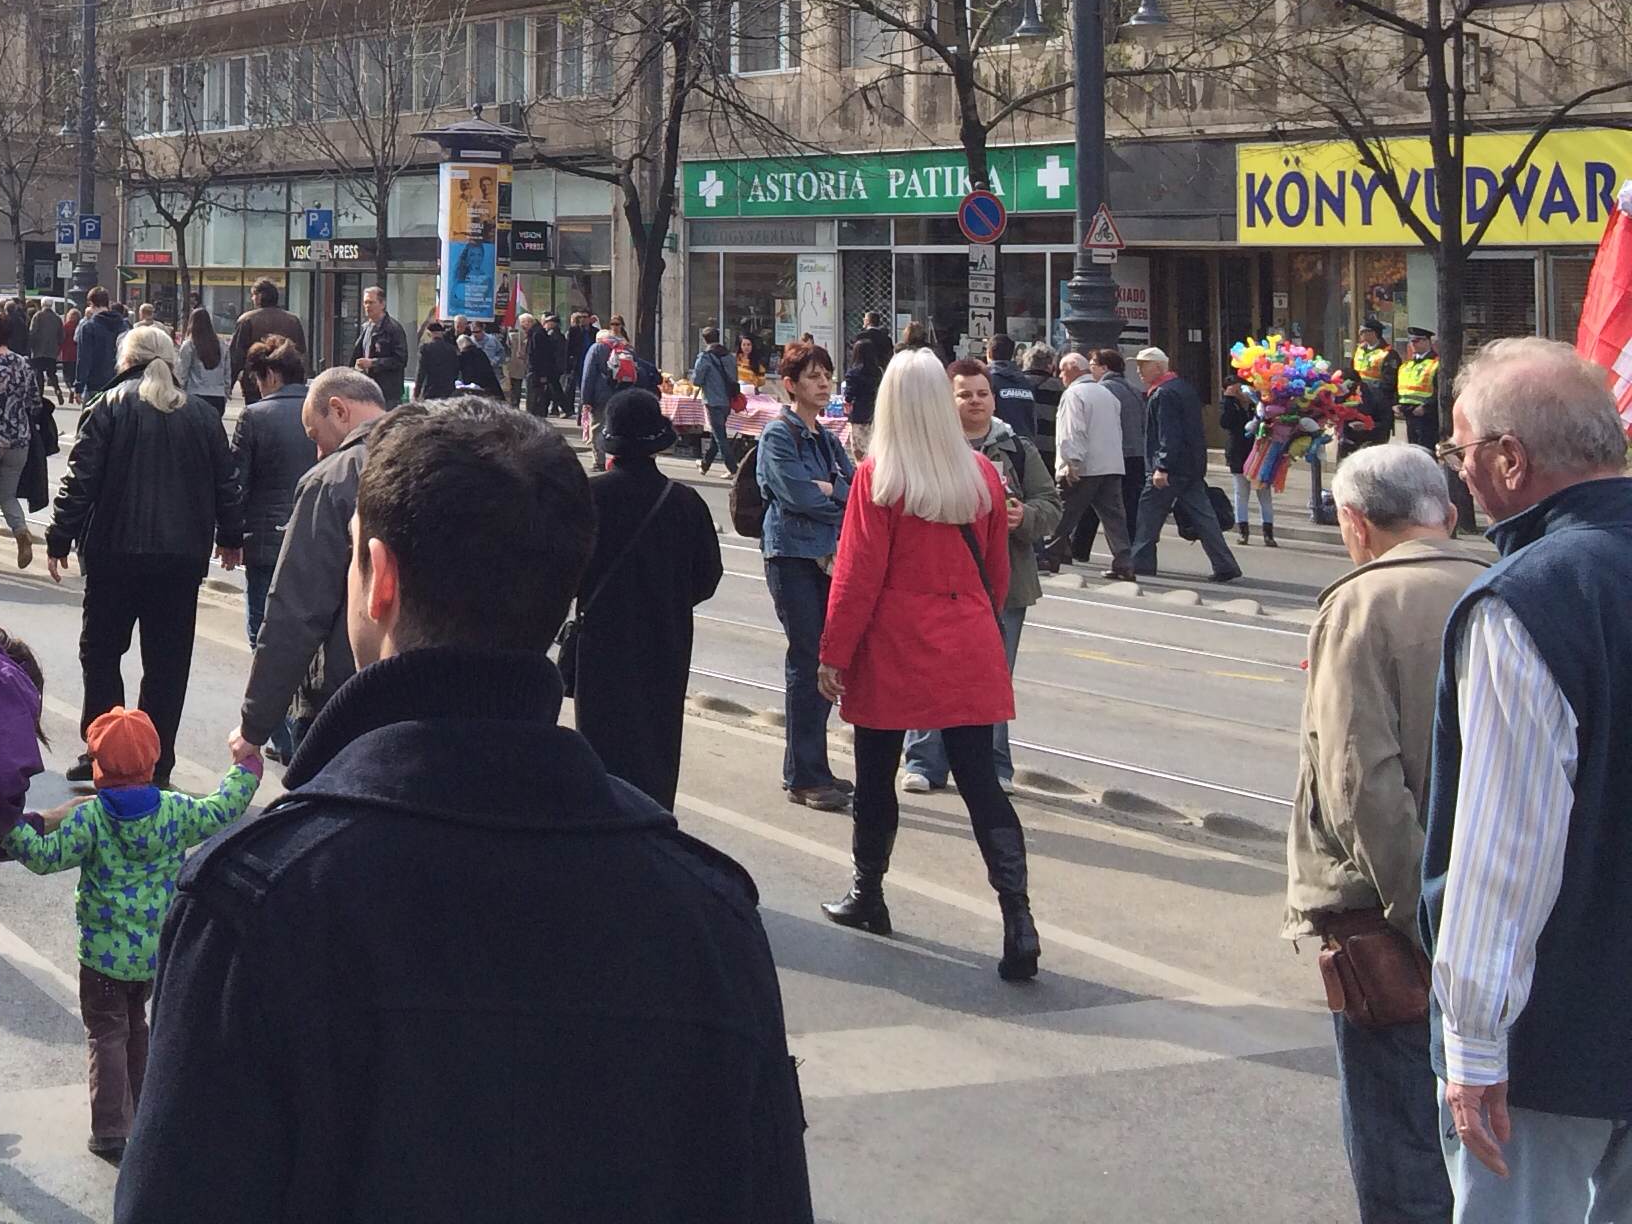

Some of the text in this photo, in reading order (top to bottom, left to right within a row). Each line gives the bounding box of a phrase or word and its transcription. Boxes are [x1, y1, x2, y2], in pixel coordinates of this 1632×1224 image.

[747, 164, 1005, 203] ASTORIA PATIKA
[308, 212, 319, 226] P
[85, 222, 96, 237] P
[291, 245, 311, 259] VISIO
[329, 244, 359, 259] PRESS
[999, 388, 1034, 401] CANADA
